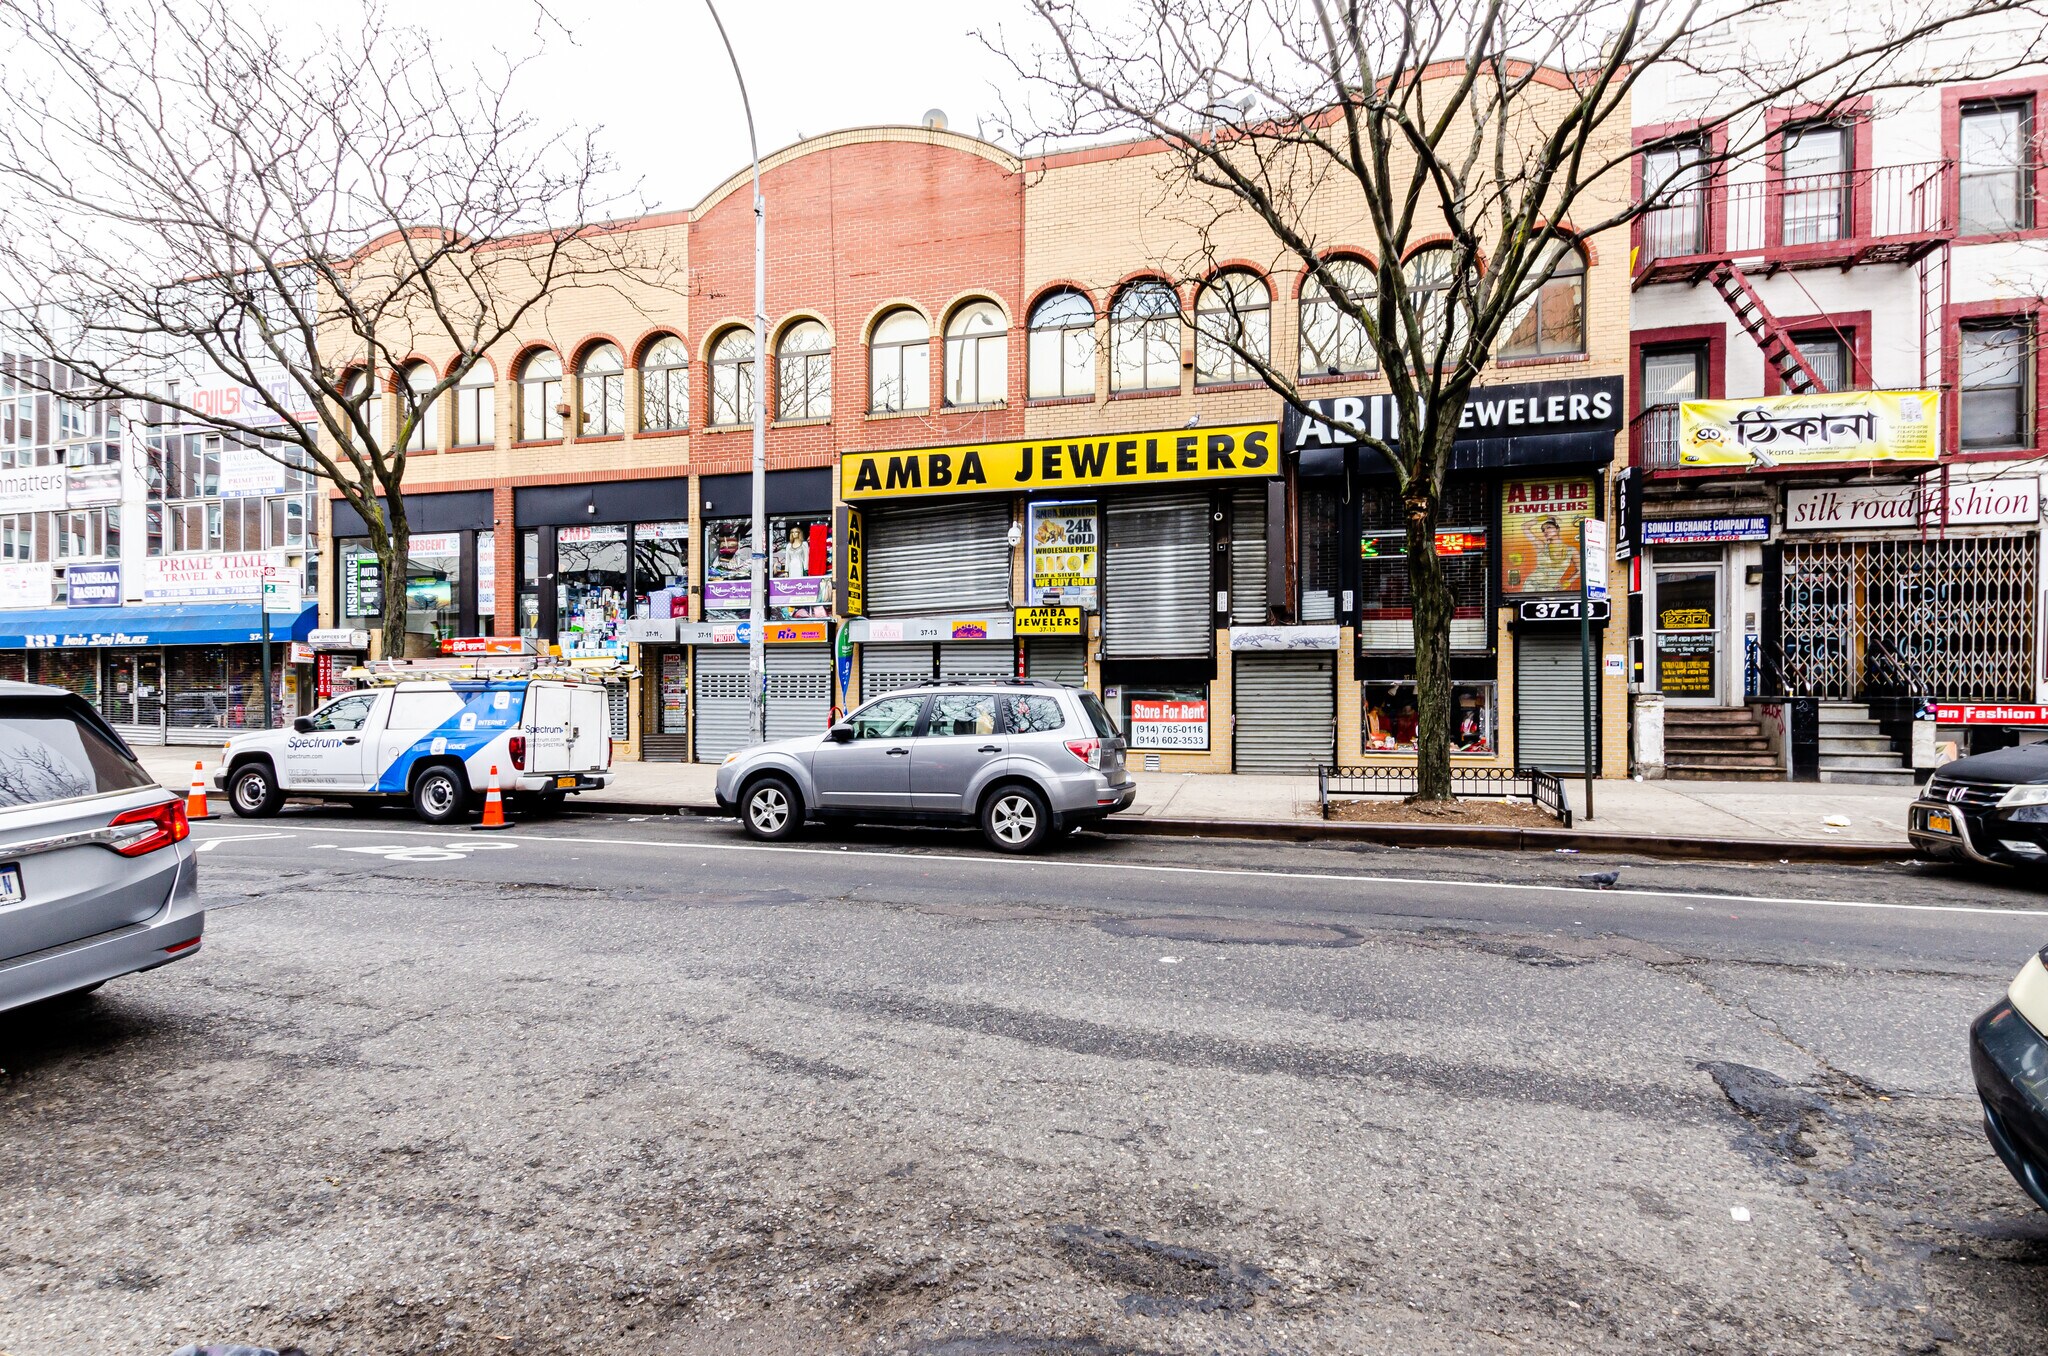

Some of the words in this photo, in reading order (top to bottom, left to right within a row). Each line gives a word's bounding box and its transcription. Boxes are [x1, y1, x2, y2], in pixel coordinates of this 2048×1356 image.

[1458, 392, 1612, 429] EWELERS
[1729, 405, 1879, 446] ঠিকানা
[1766, 449, 1794, 457] ikana
[853, 451, 987, 492] AMBA
[1014, 430, 1269, 483] JEWELERS
[1507, 483, 1589, 503] ABID
[1508, 501, 1588, 514] JEWELERS
[1794, 492, 1842, 523] silk
[1850, 490, 1919, 520] road
[1066, 519, 1092, 533] 24K
[1647, 522, 1674, 533] SONALI
[1674, 520, 1712, 532] EXCHANGE
[1713, 518, 1750, 531] COMPANY
[1750, 518, 1766, 530] INC.
[560, 526, 591, 540] JMD
[1067, 534, 1095, 545] GOLD
[407, 539, 447, 551] RESCENT
[848, 513, 860, 582] AMBA
[159, 557, 213, 572] PRIME
[220, 554, 268, 568] TIME
[480, 553, 494, 561] HOM
[69, 571, 119, 585] TANISHAA
[163, 571, 209, 582] TRAVEL
[214, 571, 223, 579] &
[229, 569, 264, 579] TOURS
[361, 567, 378, 577] AUTO
[347, 553, 358, 616] INSURANCE
[361, 579, 378, 588] HOME
[1035, 579, 1050, 587] WE
[1051, 578, 1069, 586] BUY
[1071, 577, 1096, 586] GOLD
[73, 585, 116, 599] FASHION
[266, 585, 274, 593] 2
[1030, 609, 1066, 617] AMBA
[1017, 618, 1079, 627] JEWELERS
[249, 633, 274, 641] 37-7
[714, 634, 736, 642] PHOTO
[777, 627, 797, 639] Ria
[24, 634, 57, 648] ISP
[1134, 703, 1160, 719] Store
[1162, 704, 1179, 719] For
[1181, 704, 1205, 719] Rent
[1966, 706, 2036, 719] Fashion
[525, 725, 561, 735] Spectrum
[1136, 725, 1159, 735] (914)
[1162, 725, 1203, 733] 765-0116
[288, 736, 340, 750] Spectrum
[1136, 736, 1159, 746] (914)
[1162, 736, 1204, 745] 602-3533
[0, 875, 13, 896] N
